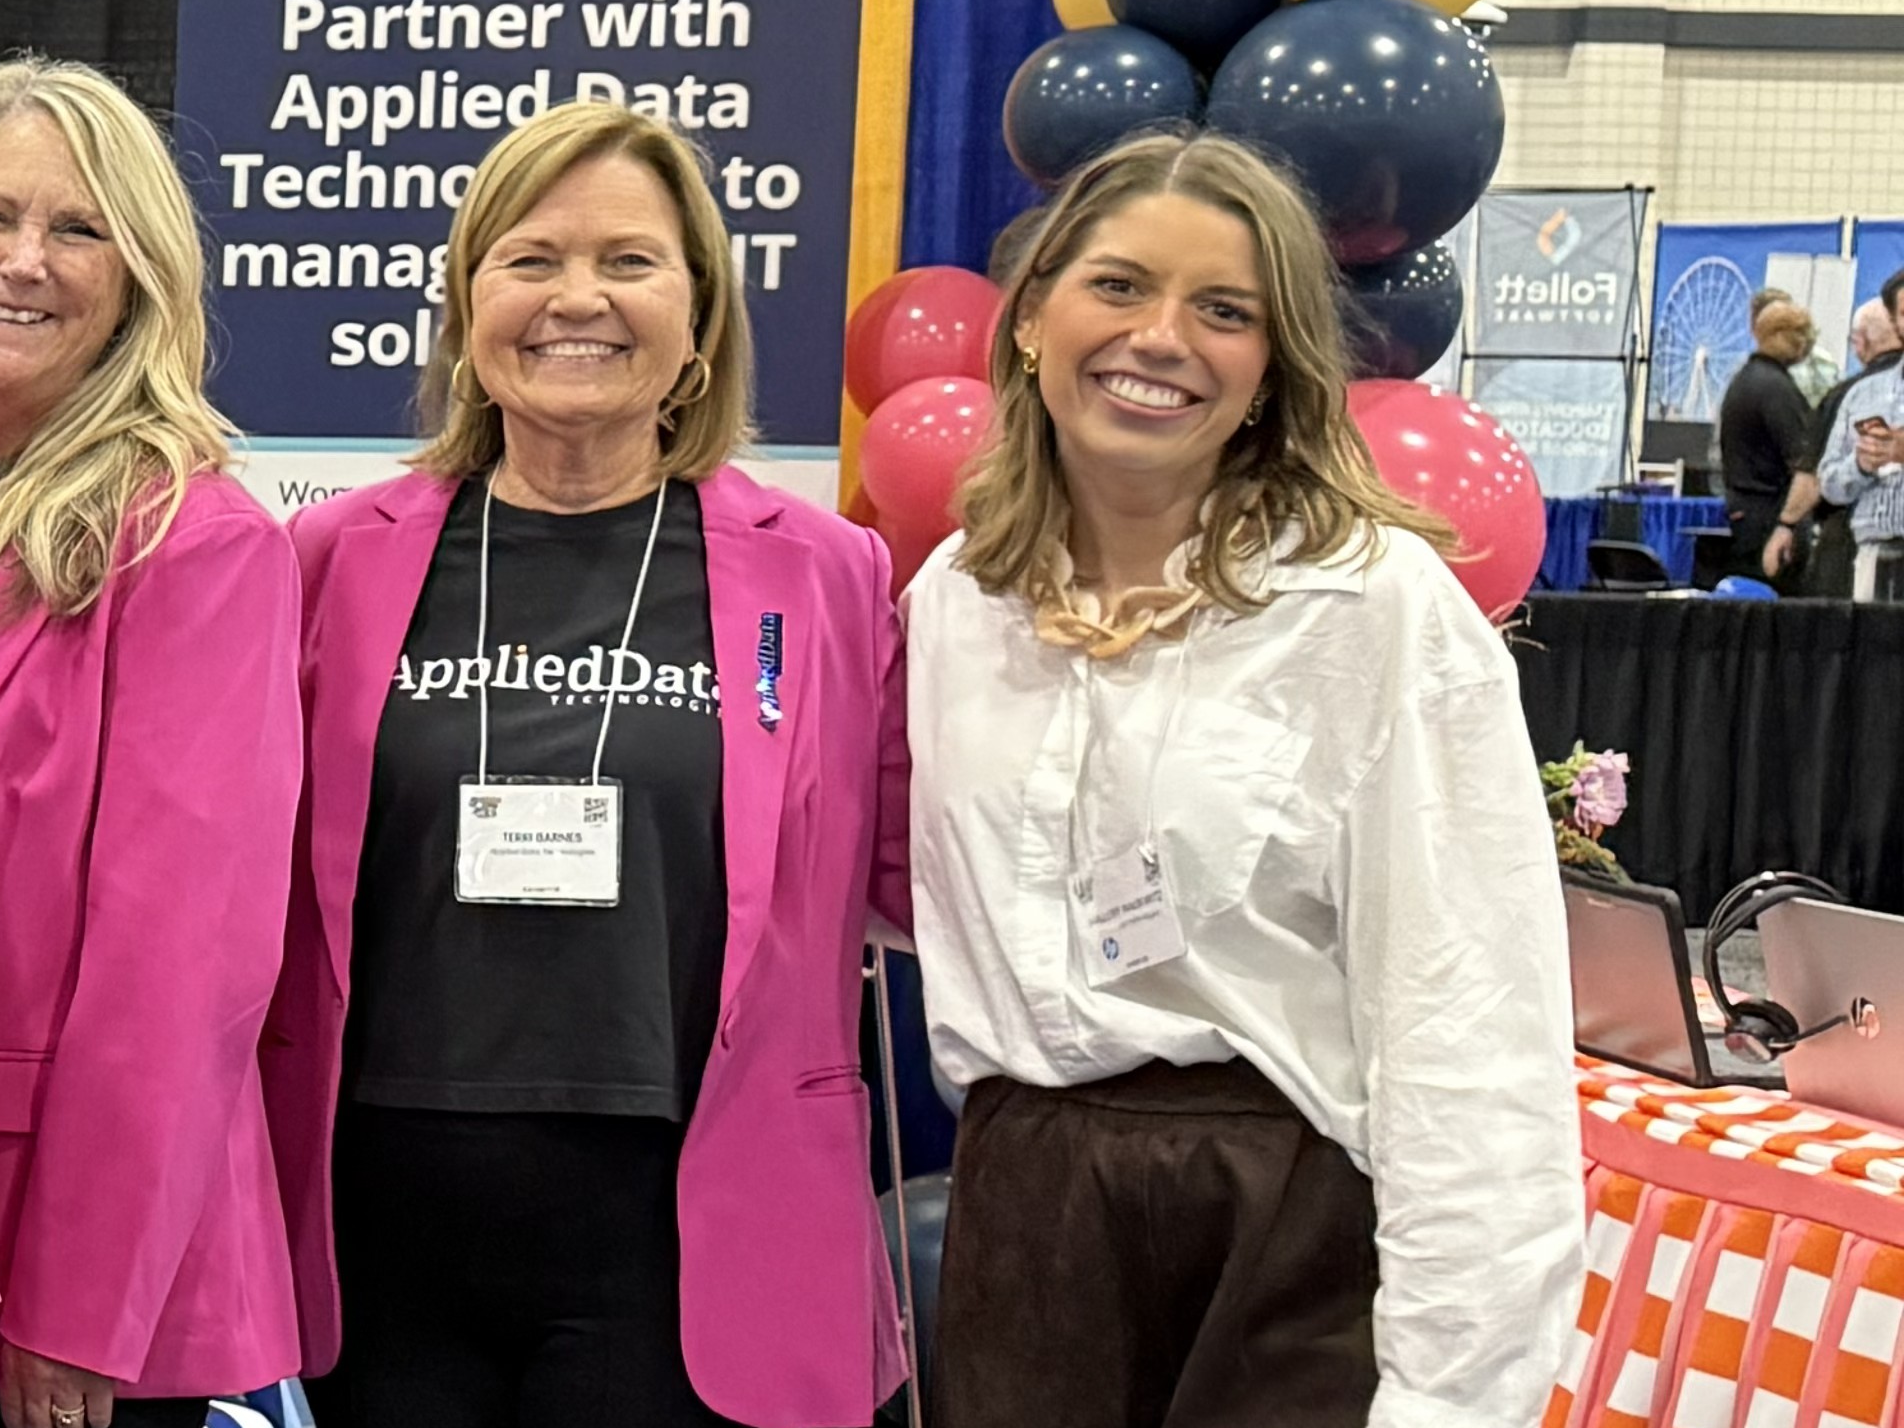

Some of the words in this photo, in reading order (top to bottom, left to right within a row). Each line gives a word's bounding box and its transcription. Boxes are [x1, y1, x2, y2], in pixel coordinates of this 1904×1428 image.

[271, 70, 550, 145] Applied
[221, 151, 477, 210] Techno
[724, 157, 800, 209] to
[221, 241, 447, 304] manag
[330, 310, 432, 366] sol
